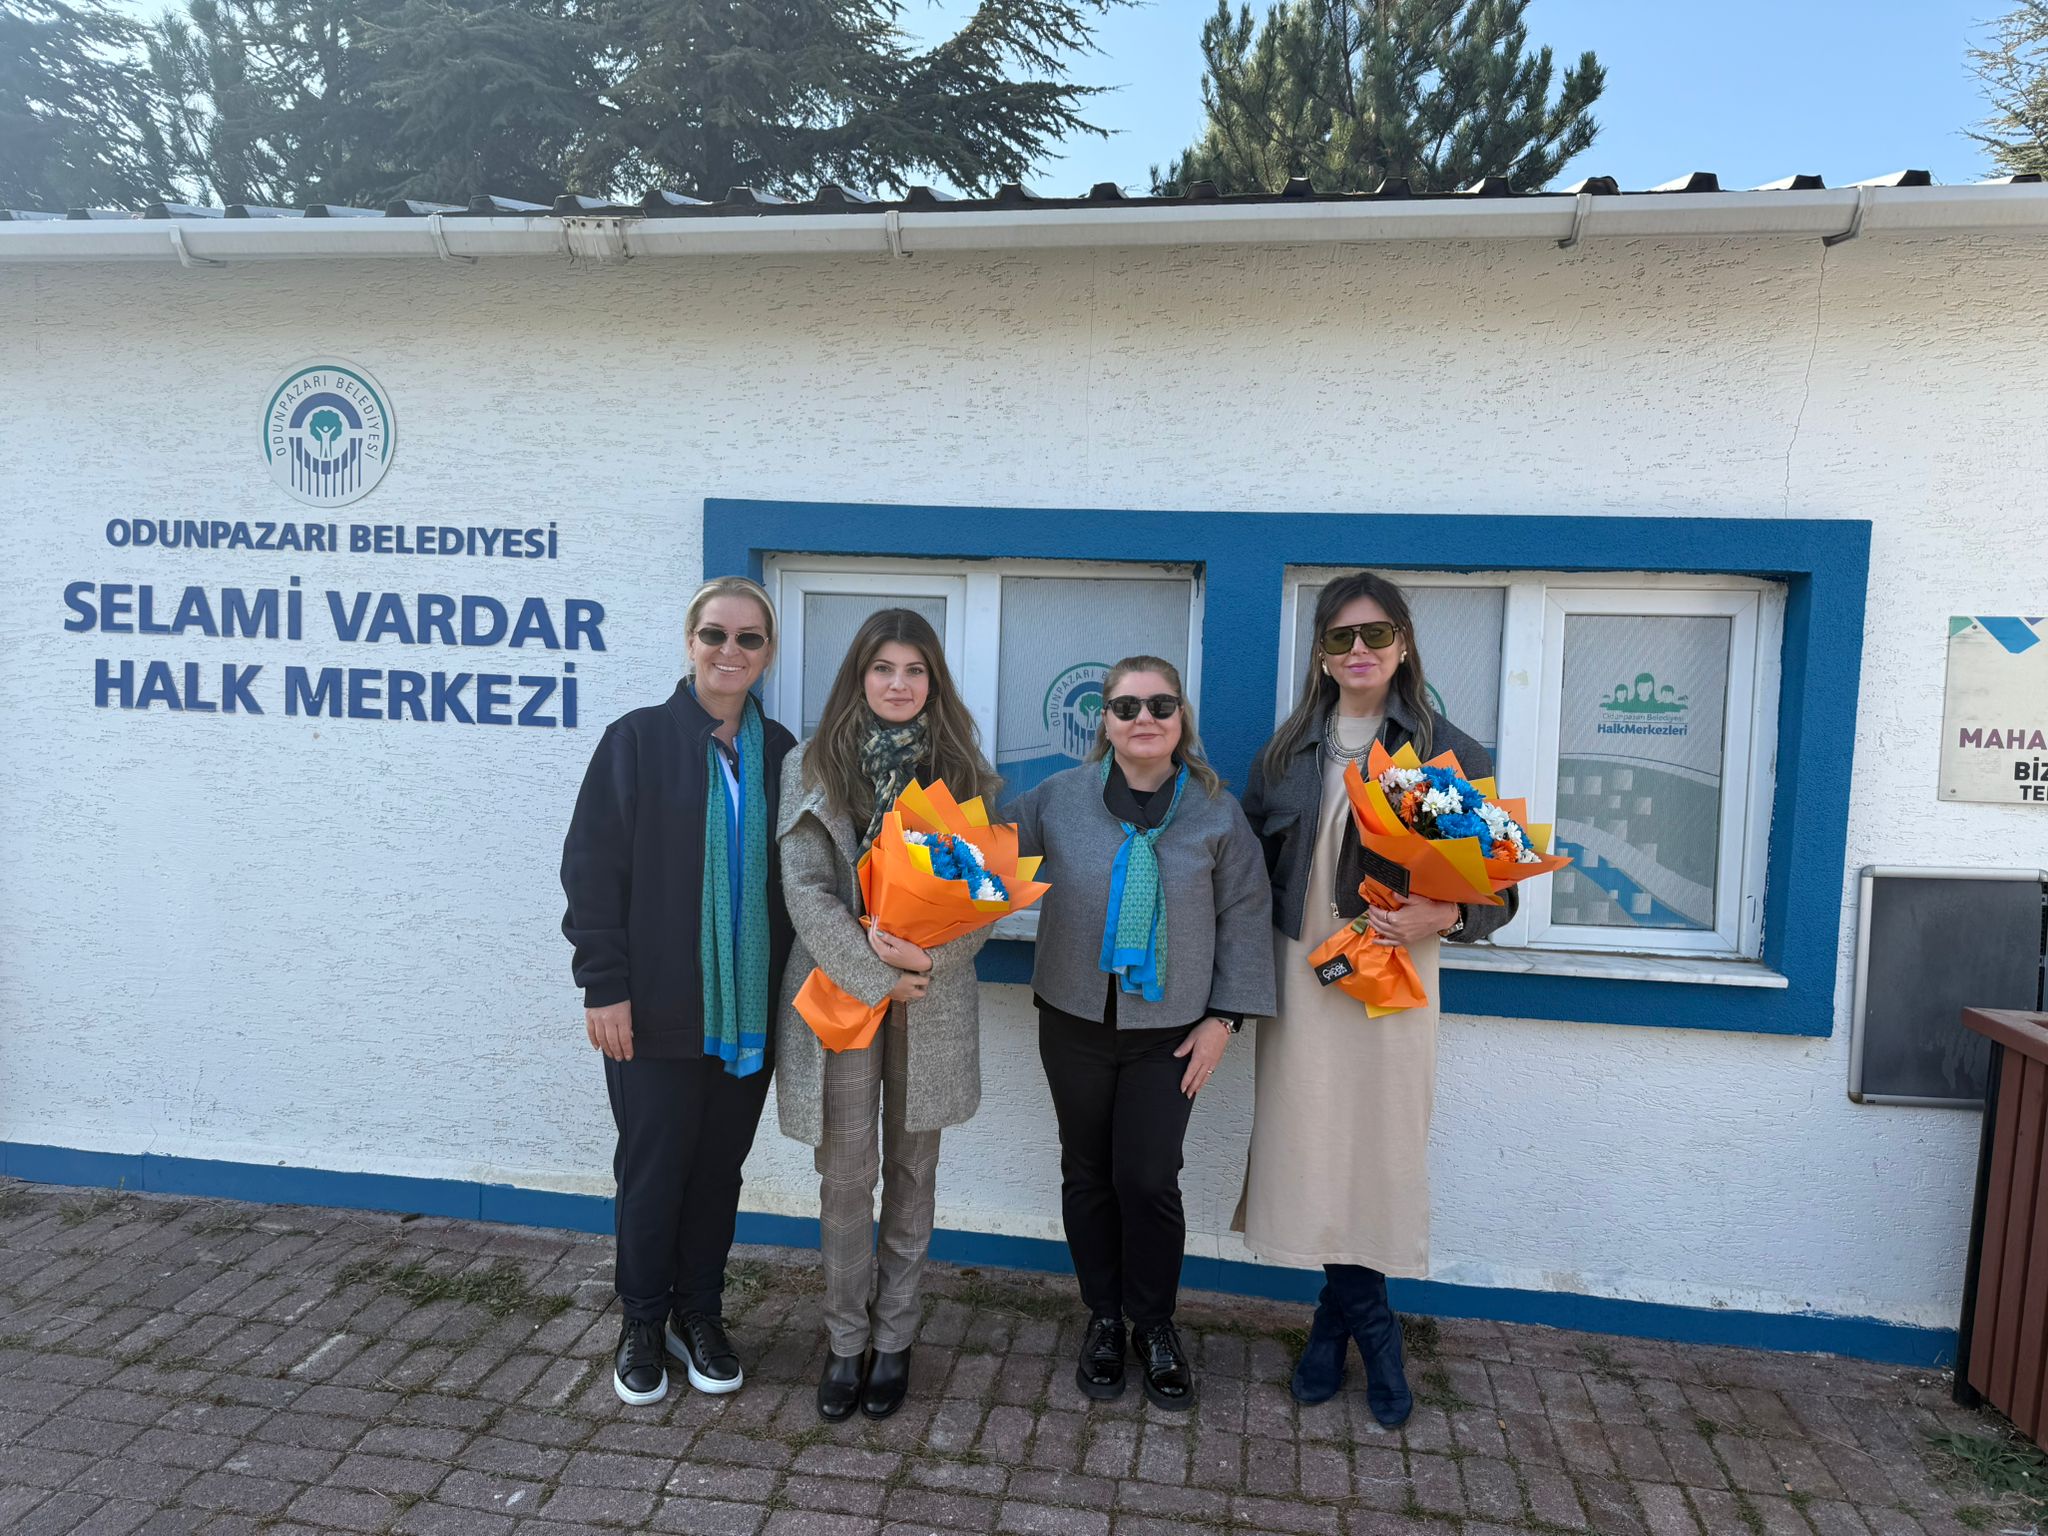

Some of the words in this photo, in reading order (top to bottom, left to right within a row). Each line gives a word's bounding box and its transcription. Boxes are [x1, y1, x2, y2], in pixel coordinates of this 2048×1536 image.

[272, 375, 327, 456] ODUNPAZARI
[335, 377, 380, 460] BELEDİYESİ
[105, 518, 337, 552] ODUNPAZARI
[63, 575, 303, 640] SELAMİ
[325, 590, 608, 651] VARDAR
[94, 658, 265, 715] HALK
[284, 661, 578, 728] MERKEZİ
[1050, 669, 1094, 727] ODUNPAZARI
[1597, 723, 1688, 736] HalkMerkezleri
[2019, 785, 2048, 801] TE
